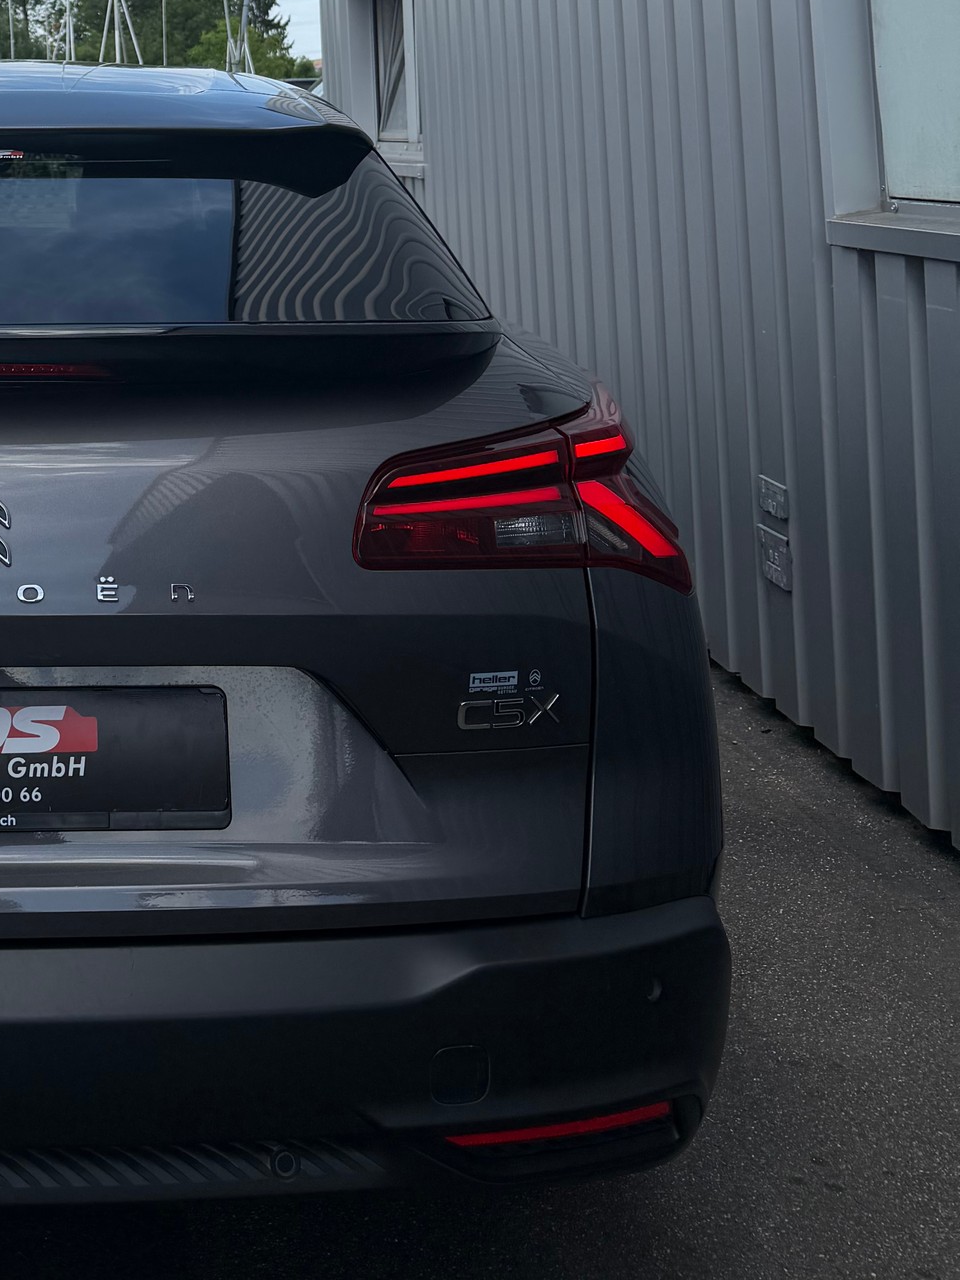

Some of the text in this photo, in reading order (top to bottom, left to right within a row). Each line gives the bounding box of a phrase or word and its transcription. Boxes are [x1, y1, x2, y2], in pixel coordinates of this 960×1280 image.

[472, 675, 516, 685] heller
[7, 755, 86, 779] GmbH
[19, 786, 42, 801] 66
